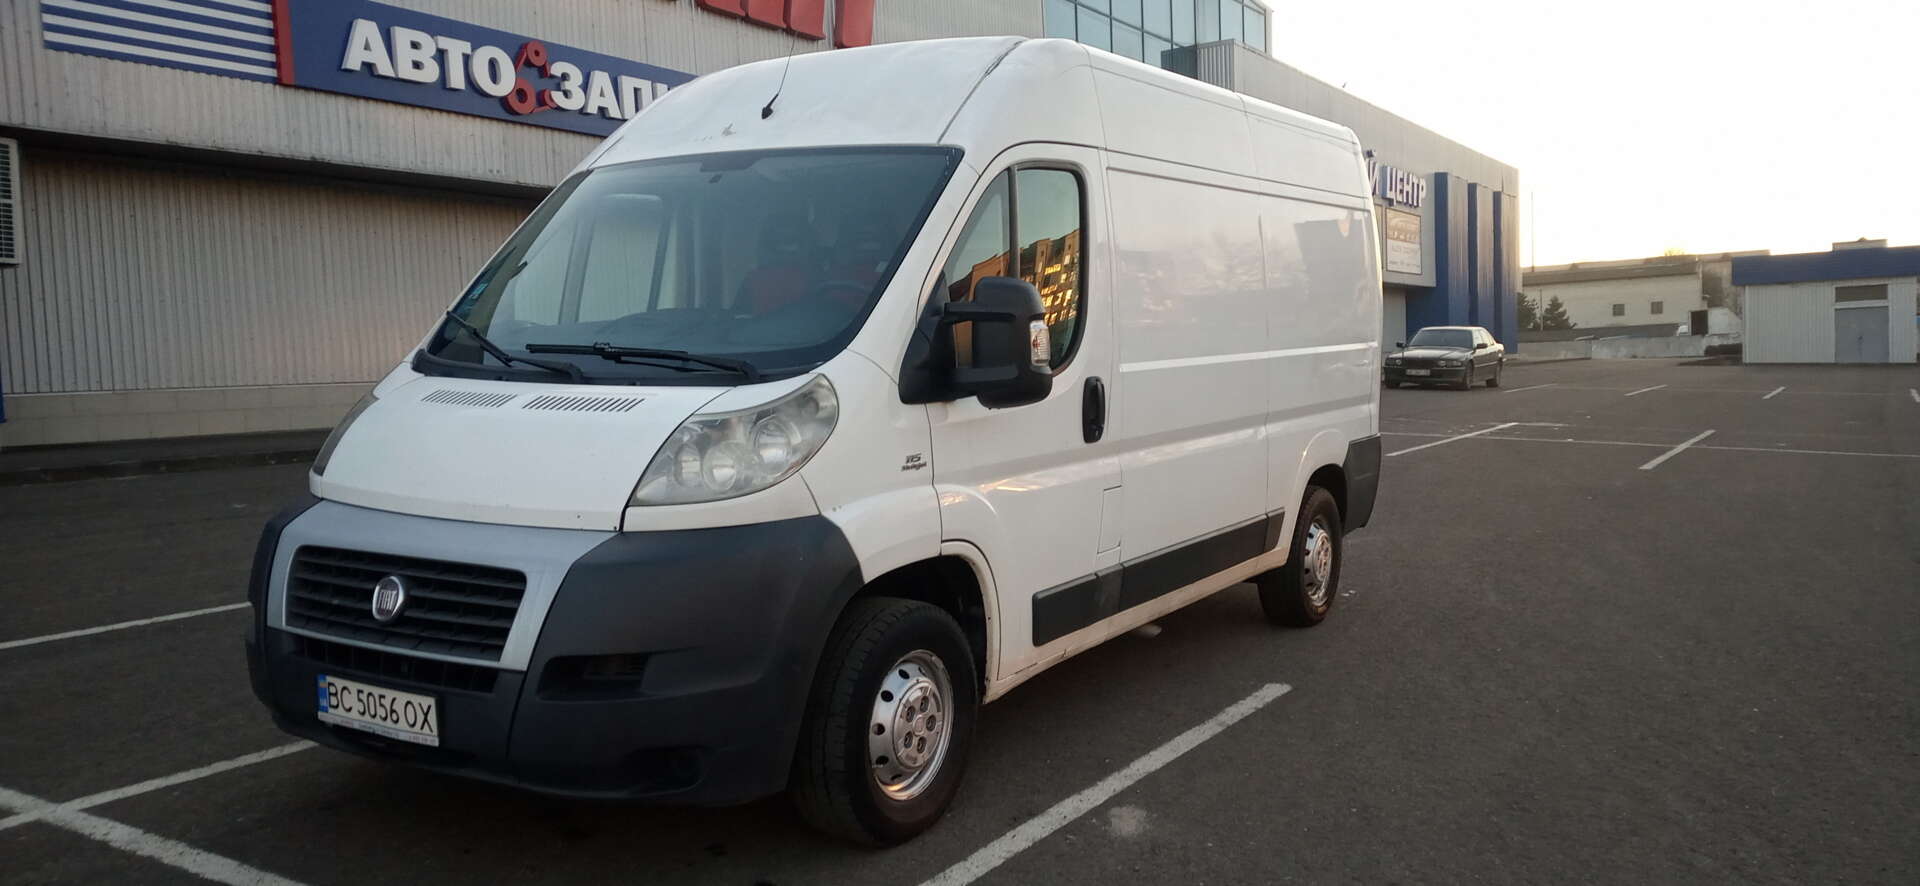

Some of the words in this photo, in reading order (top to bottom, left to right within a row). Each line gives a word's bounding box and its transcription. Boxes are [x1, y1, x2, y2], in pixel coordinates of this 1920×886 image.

[1384, 166, 1427, 207] ЦЕНТР
[378, 589, 398, 610] FIAT
[327, 681, 353, 713] BC
[356, 689, 400, 725] 5056
[404, 700, 434, 733] OX
